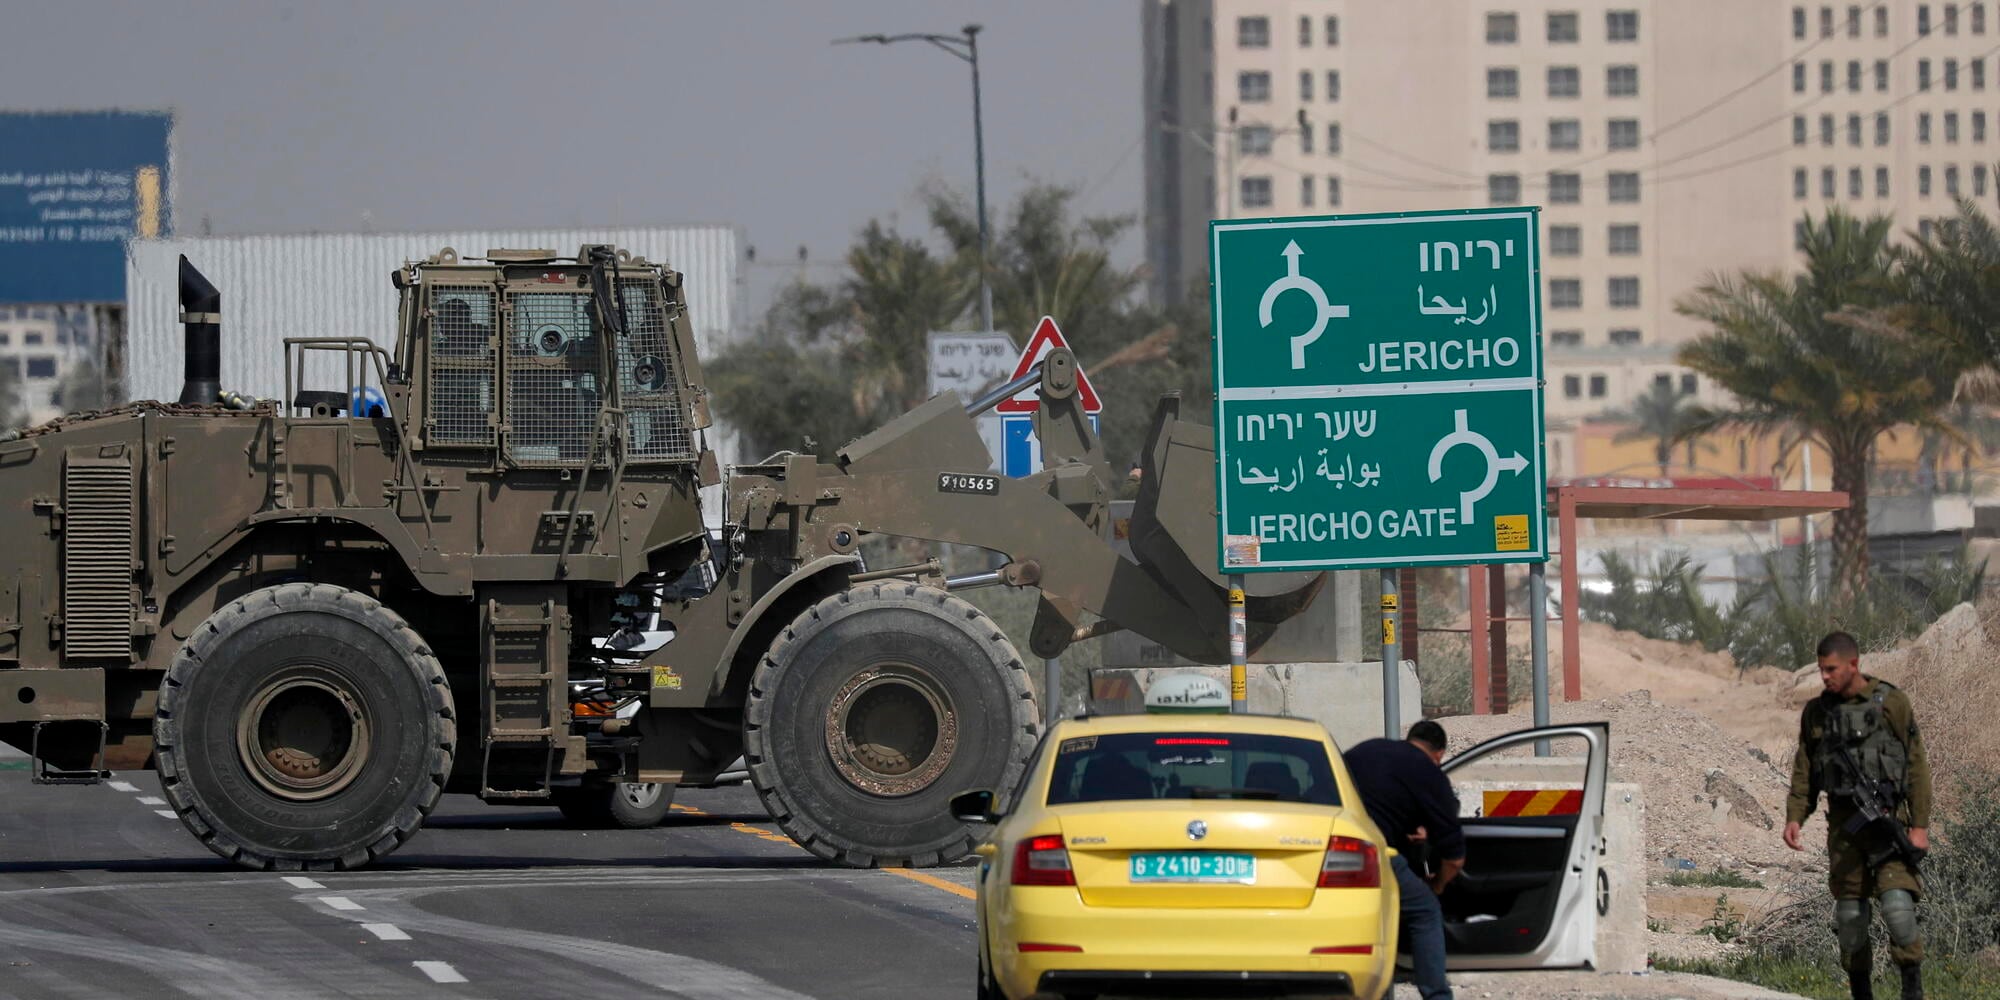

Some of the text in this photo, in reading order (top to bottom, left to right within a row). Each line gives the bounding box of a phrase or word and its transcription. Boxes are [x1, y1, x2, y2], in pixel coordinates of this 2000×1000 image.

[1419, 239, 1514, 272] יריחו
[1417, 283, 1497, 325] اريحا
[1358, 336, 1520, 373] JERICHO
[1237, 409, 1377, 442] שער יריחו
[941, 475, 995, 490] 910565
[1237, 448, 1381, 493] بوابة اريحا
[1378, 508, 1457, 539] GATE
[1157, 689, 1189, 704] taxi
